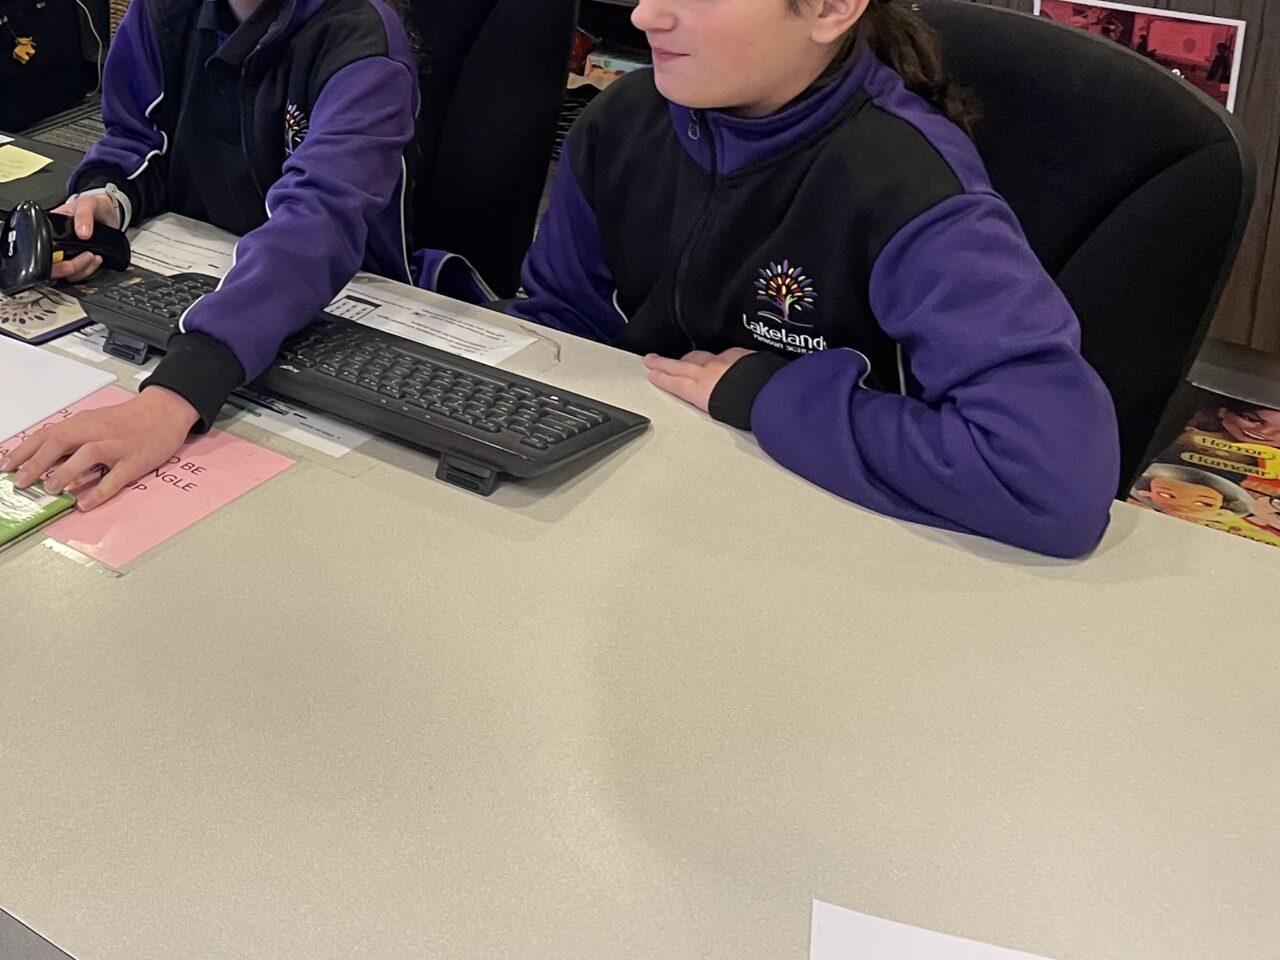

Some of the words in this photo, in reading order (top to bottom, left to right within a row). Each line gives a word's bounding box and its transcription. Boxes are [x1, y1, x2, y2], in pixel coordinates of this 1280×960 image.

[1202, 437, 1268, 456] Horror
[180, 461, 207, 476] BE
[1188, 454, 1272, 477] Humour
[154, 468, 198, 492] NGLE
